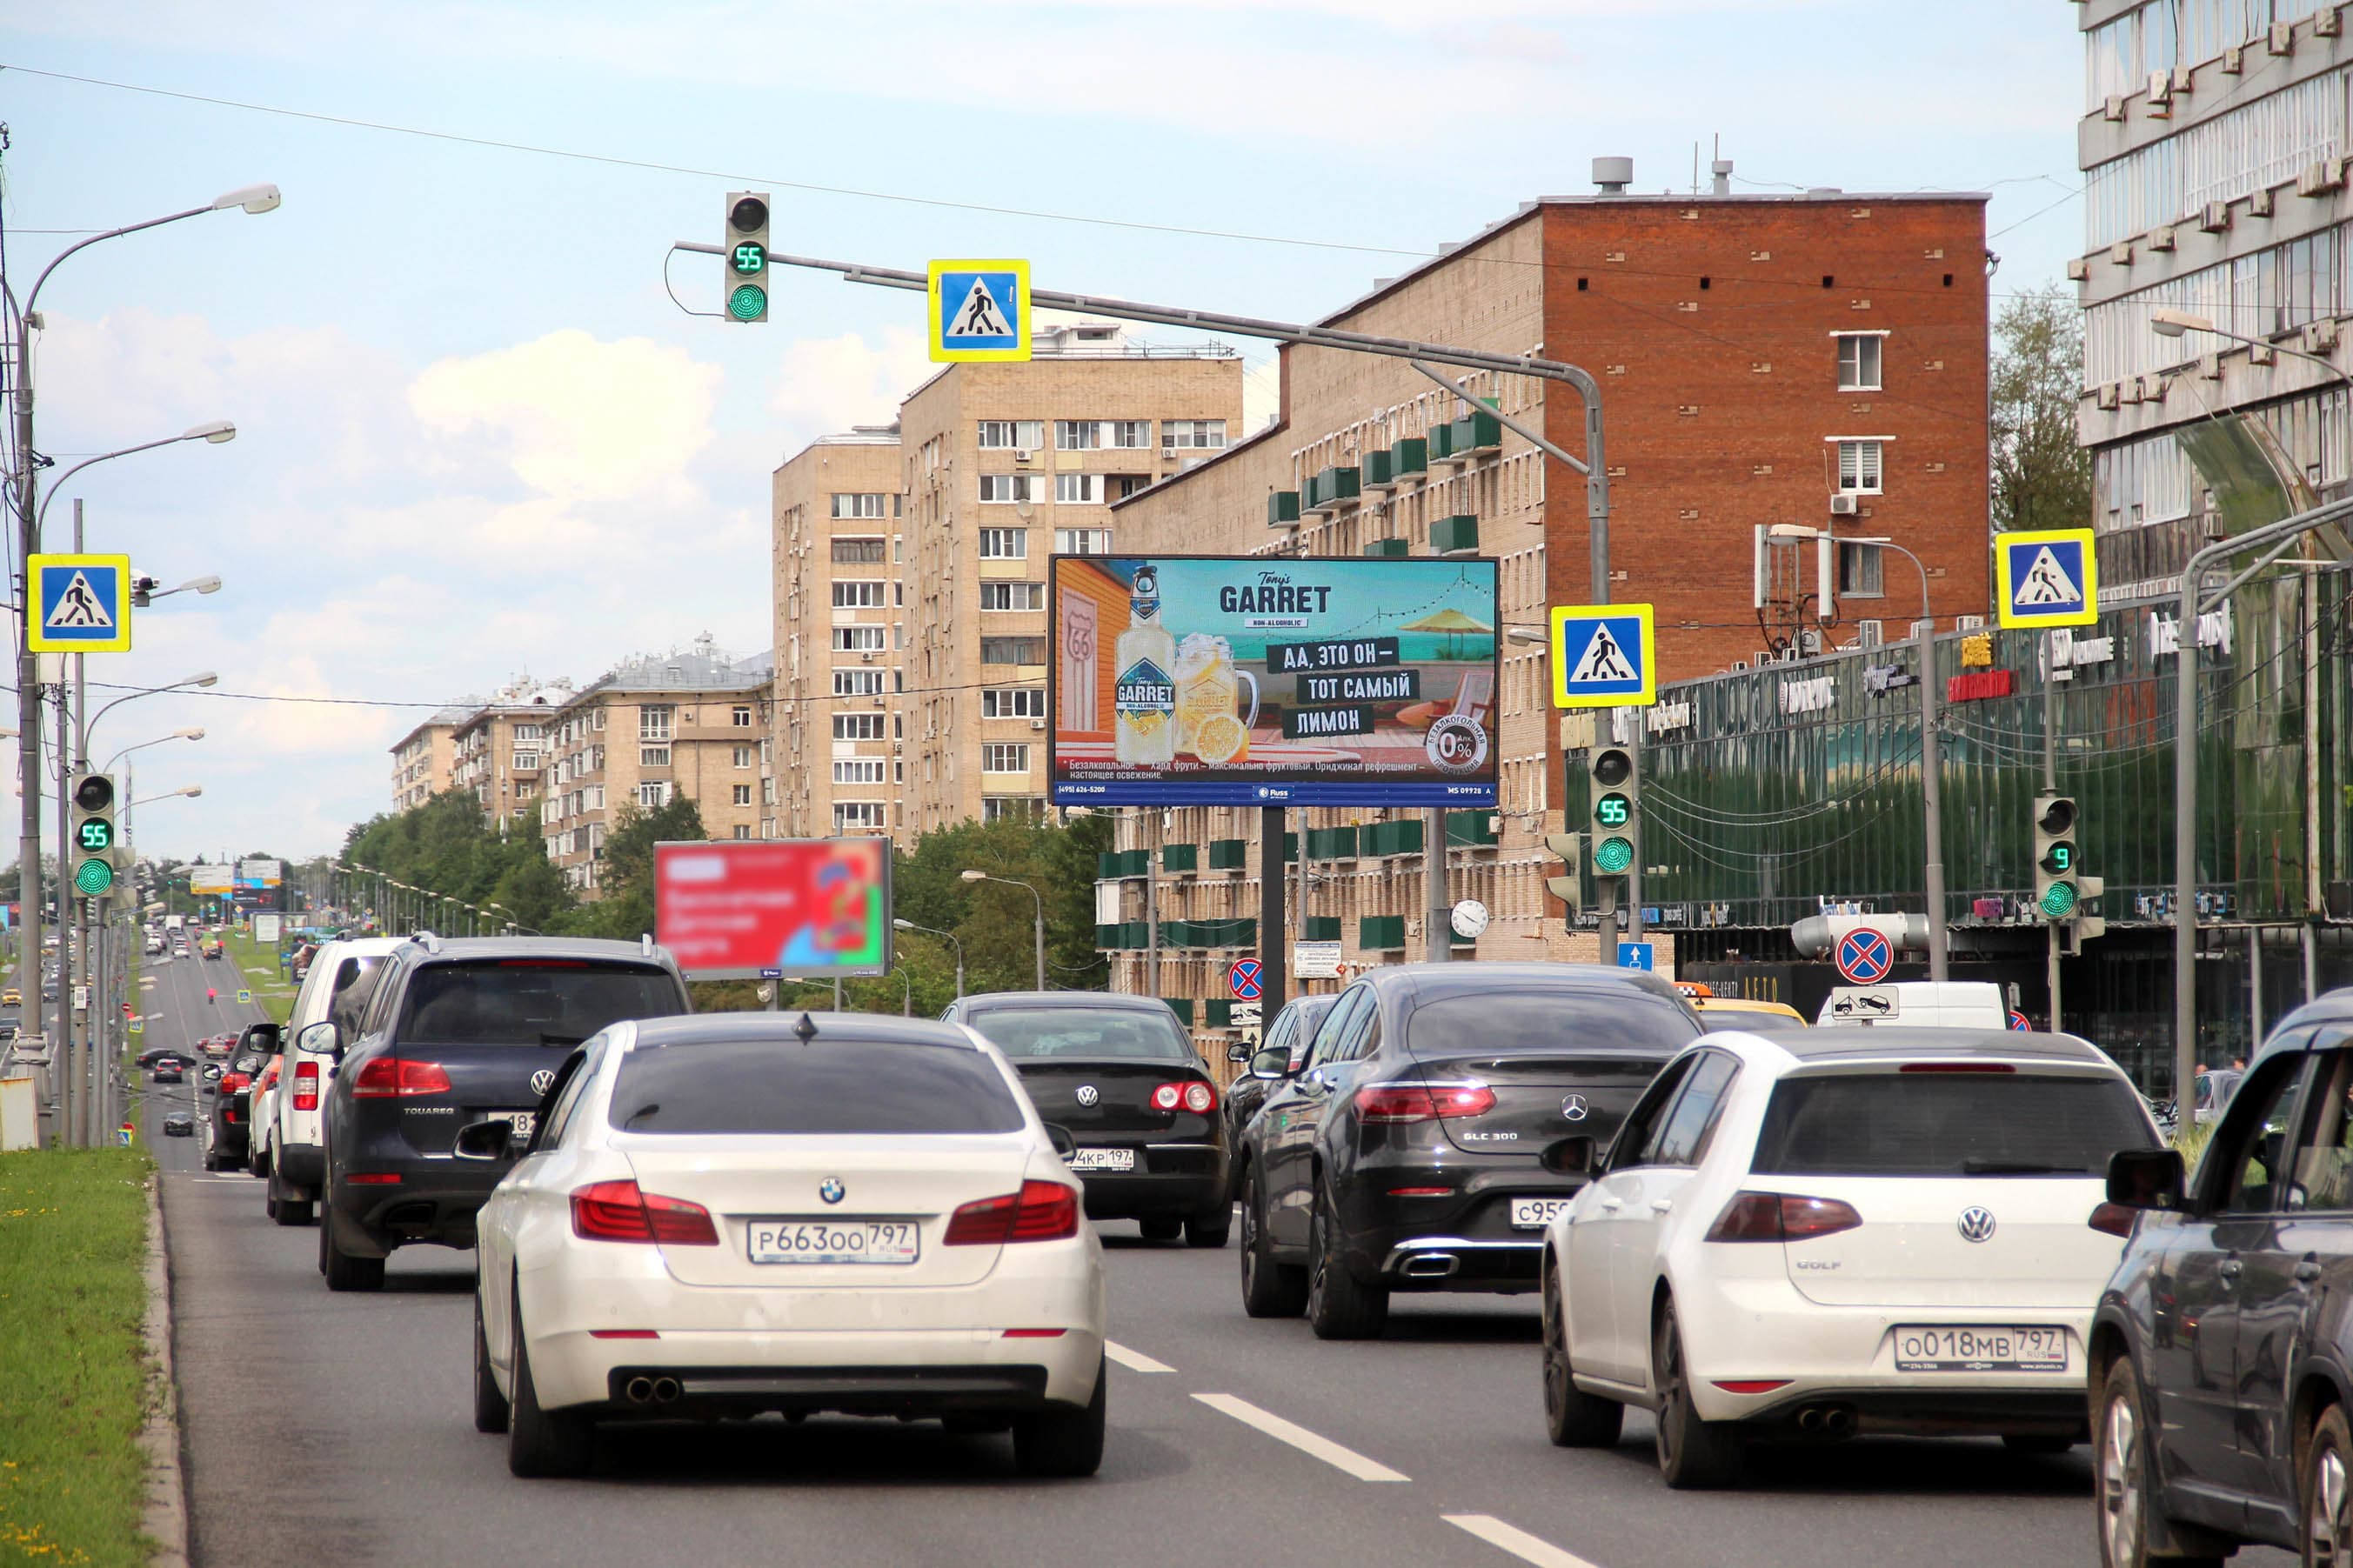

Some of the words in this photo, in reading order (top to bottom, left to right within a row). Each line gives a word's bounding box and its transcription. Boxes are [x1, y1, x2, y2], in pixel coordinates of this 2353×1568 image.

[737, 247, 761, 269] 55
[1258, 570, 1291, 586] Tony's
[1220, 585, 1331, 613] GARRET
[1073, 630, 1089, 657] 66
[1284, 647, 1314, 669] ДА,
[1318, 644, 1348, 665] ЭТО
[1118, 685, 1173, 702] GARRET
[1308, 678, 1339, 699] ТОТ
[1343, 672, 1410, 698] САМЫЙ
[1297, 709, 1360, 734] ЛИМОН
[1427, 716, 1486, 744] БЕЗАЛКОГОЛЬНАЯ
[1070, 771, 1114, 780] настоящее
[1151, 762, 1171, 771] Хард
[1173, 762, 1199, 772] фрути
[1315, 761, 1363, 772] Ориджинал
[1365, 762, 1417, 772] рефрешмент
[1434, 758, 1481, 775] ПРОДУКЦИЯ
[1601, 800, 1627, 822] 55
[83, 825, 106, 846] 55
[2057, 848, 2069, 868] 9
[870, 1224, 908, 1244] 797
[1796, 1261, 1842, 1270] GOLF
[2015, 1331, 2056, 1350] 797
